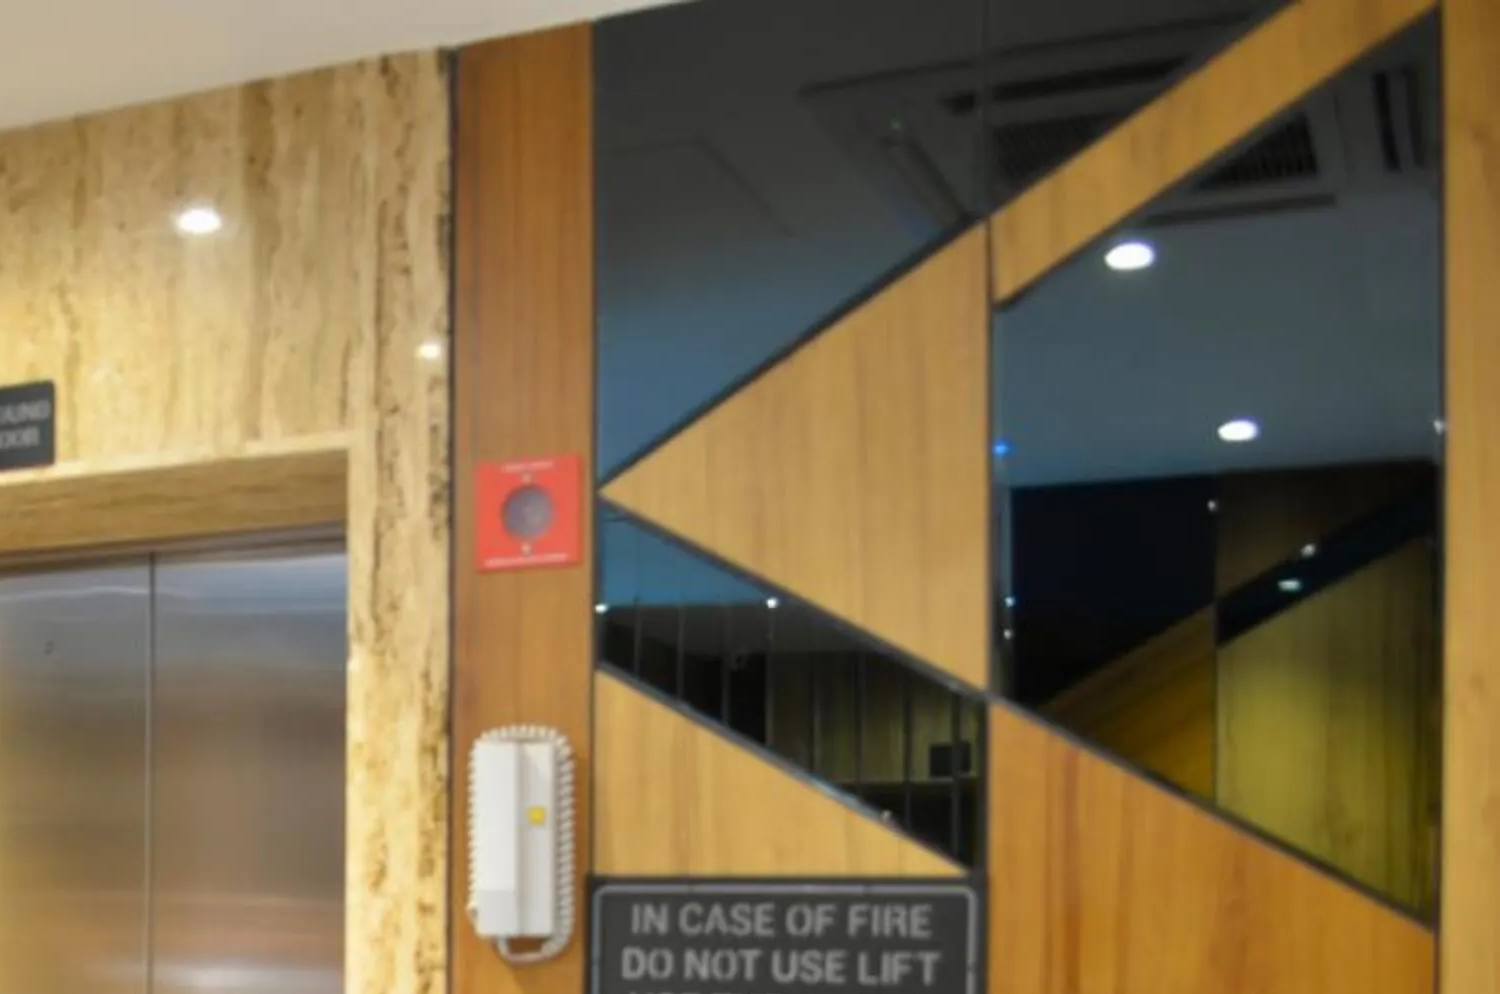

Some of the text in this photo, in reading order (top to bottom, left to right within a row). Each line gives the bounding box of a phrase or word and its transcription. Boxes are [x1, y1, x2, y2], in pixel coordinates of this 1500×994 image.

[631, 903, 933, 938] IN CASE OF FIRE
[621, 947, 941, 986] DO NOT USE LIFT
